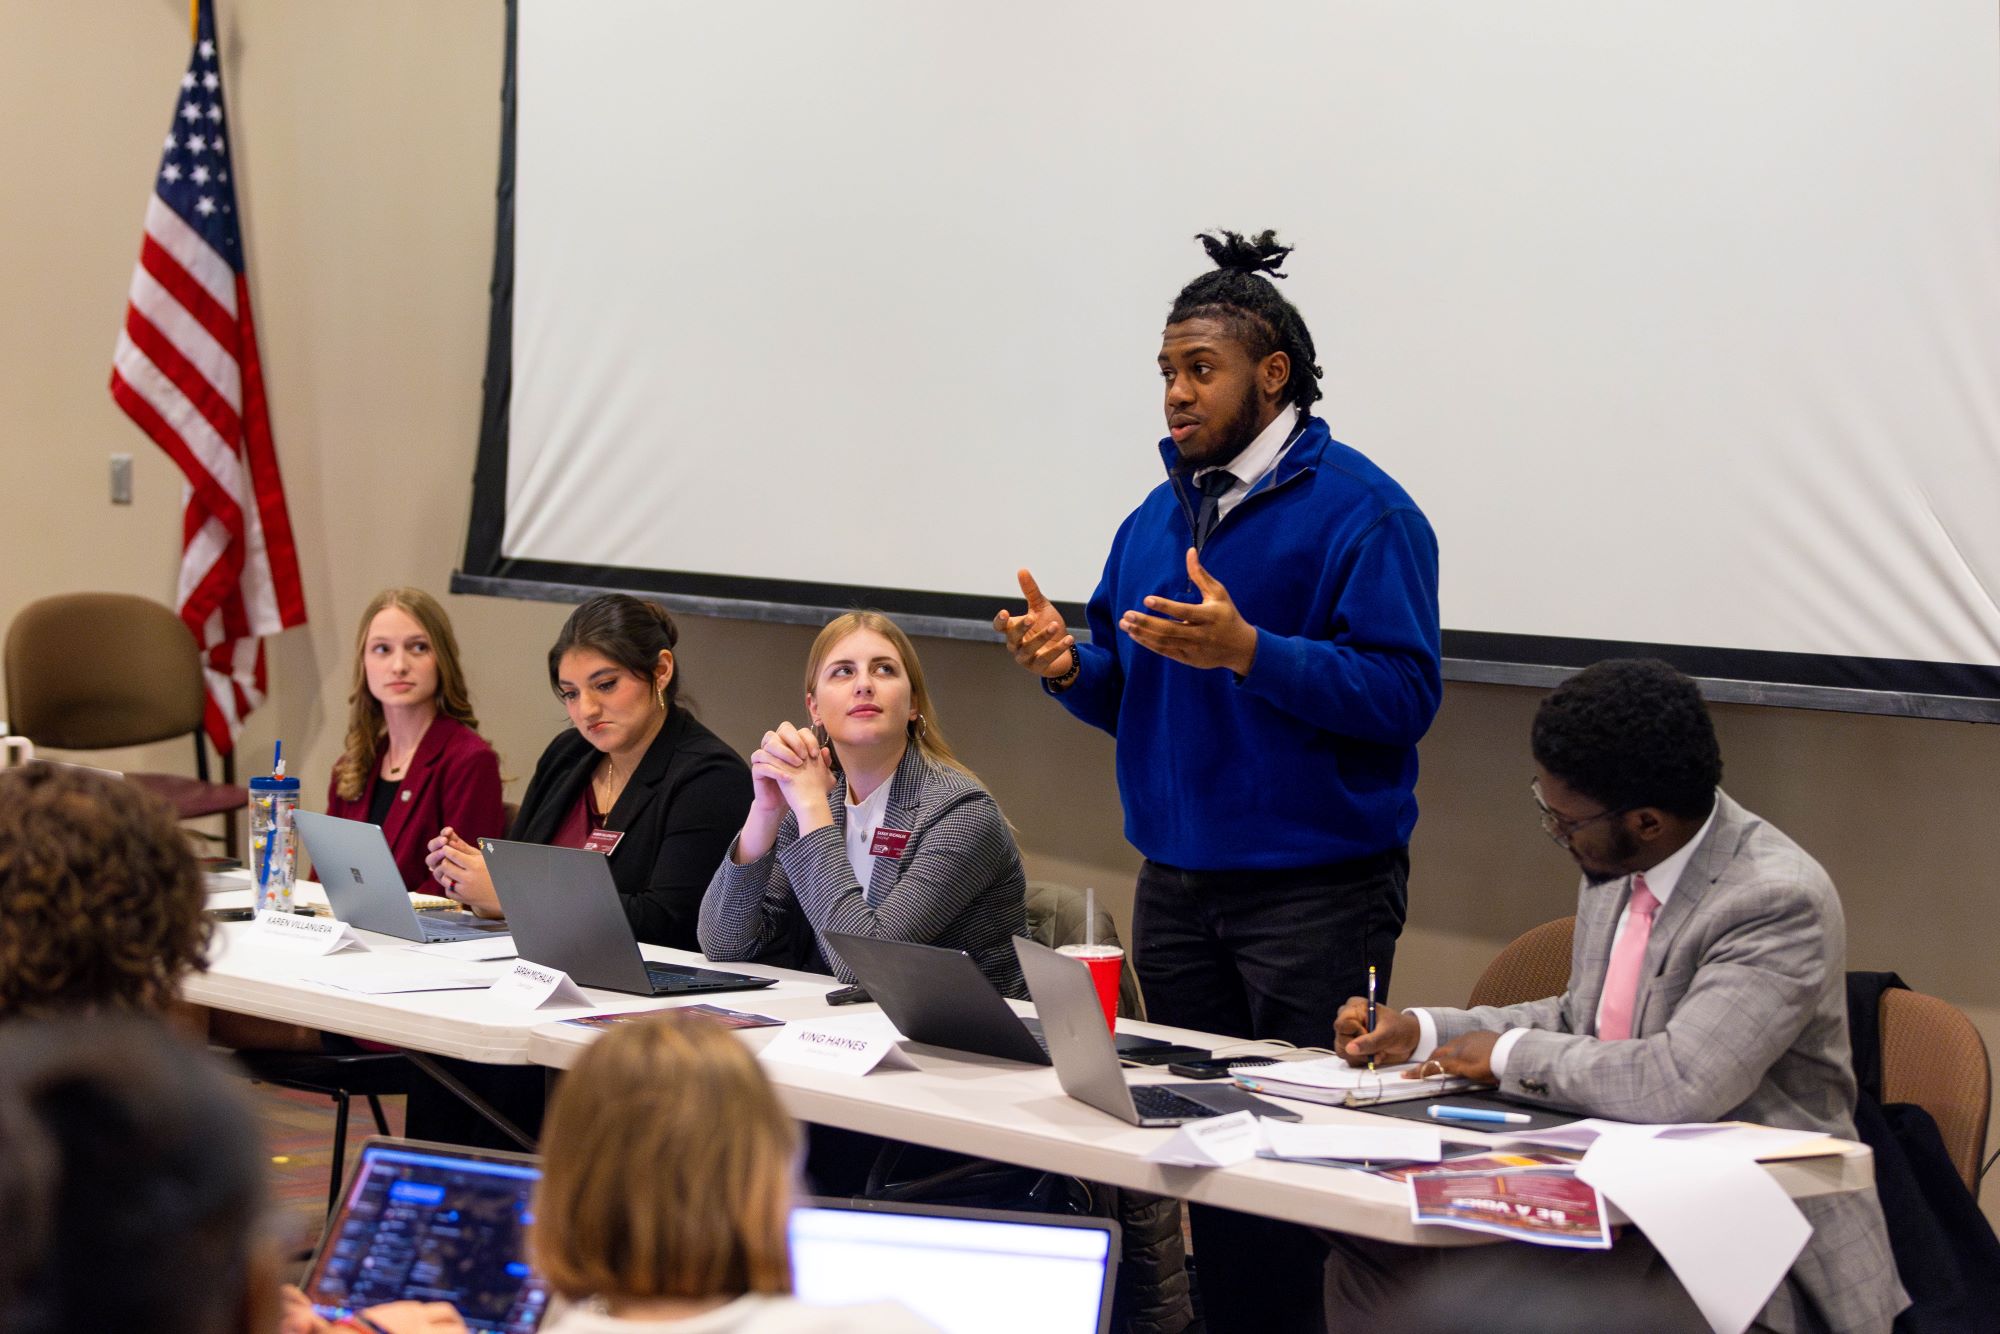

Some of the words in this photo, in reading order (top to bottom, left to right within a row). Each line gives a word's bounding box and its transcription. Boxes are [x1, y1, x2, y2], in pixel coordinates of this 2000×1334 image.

[267, 917, 290, 927] KAREN
[291, 919, 333, 933] VILLANUEVA
[514, 964, 532, 977] SARAH
[799, 1030, 826, 1043] KING
[826, 1036, 868, 1051] HAYNES
[1514, 1204, 1531, 1216] A
[1536, 1207, 1566, 1225] BE
